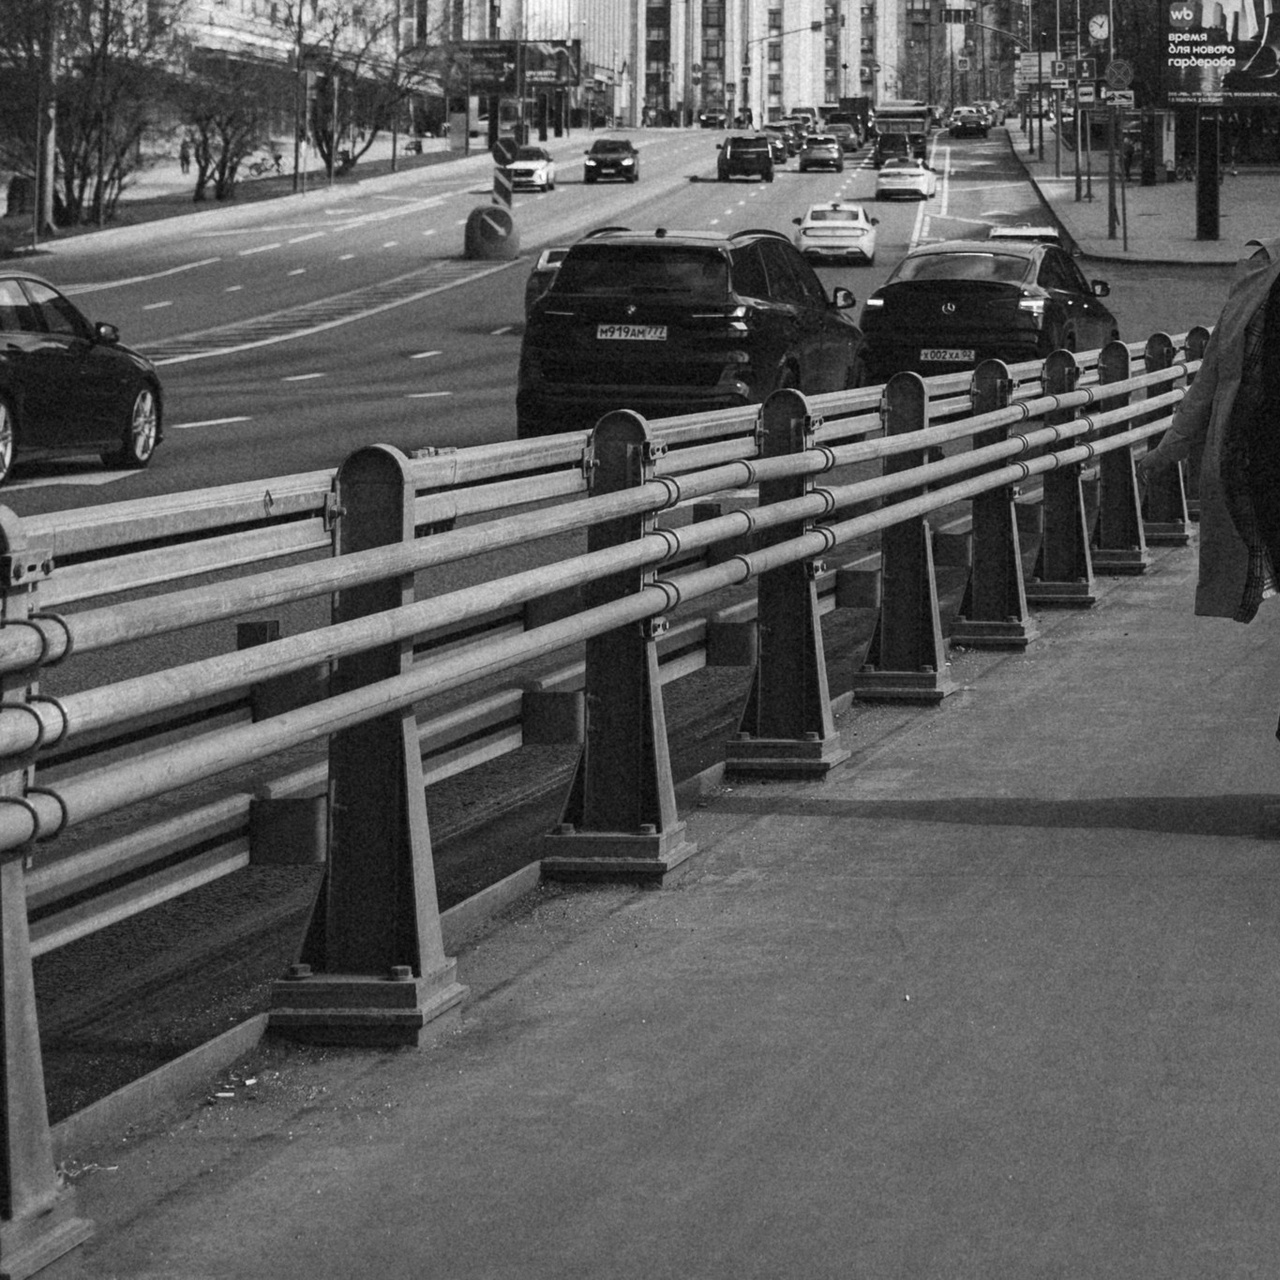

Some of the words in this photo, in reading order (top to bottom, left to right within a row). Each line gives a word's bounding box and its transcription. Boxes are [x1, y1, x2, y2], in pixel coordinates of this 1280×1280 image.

[1170, 7, 1194, 21] wb
[1168, 32, 1208, 44] время
[1168, 42, 1191, 54] для
[1192, 45, 1236, 54] нового
[1168, 55, 1237, 69] гардероба
